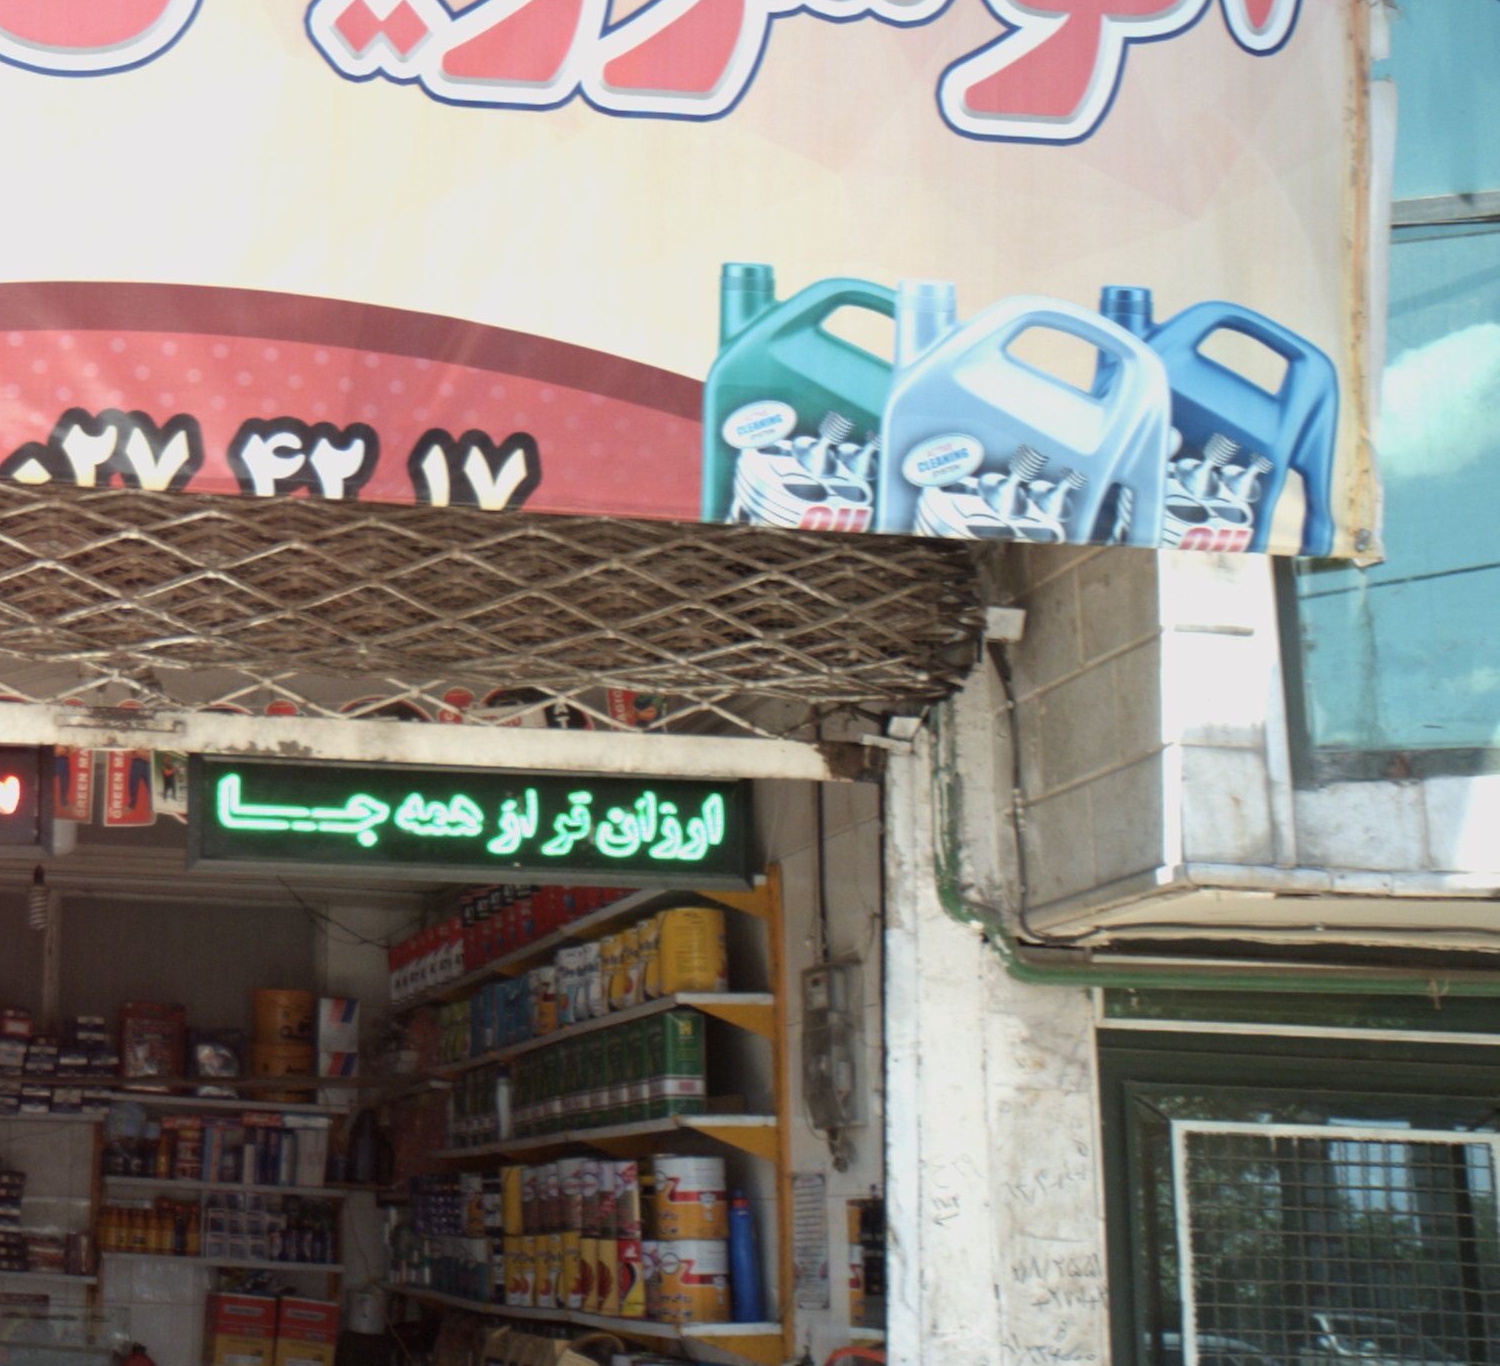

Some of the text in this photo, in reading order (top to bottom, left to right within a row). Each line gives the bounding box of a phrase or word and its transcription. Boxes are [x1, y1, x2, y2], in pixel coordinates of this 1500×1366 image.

[3, 414, 198, 492] ۰۲۷
[234, 423, 371, 500] ۴۲
[415, 434, 534, 511] ۱۷
[77, 773, 88, 818] GREEN
[112, 772, 123, 819] GREEN
[217, 773, 391, 847] جا
[395, 791, 485, 838] همه
[487, 786, 539, 855] از
[595, 791, 725, 858] ارزان
